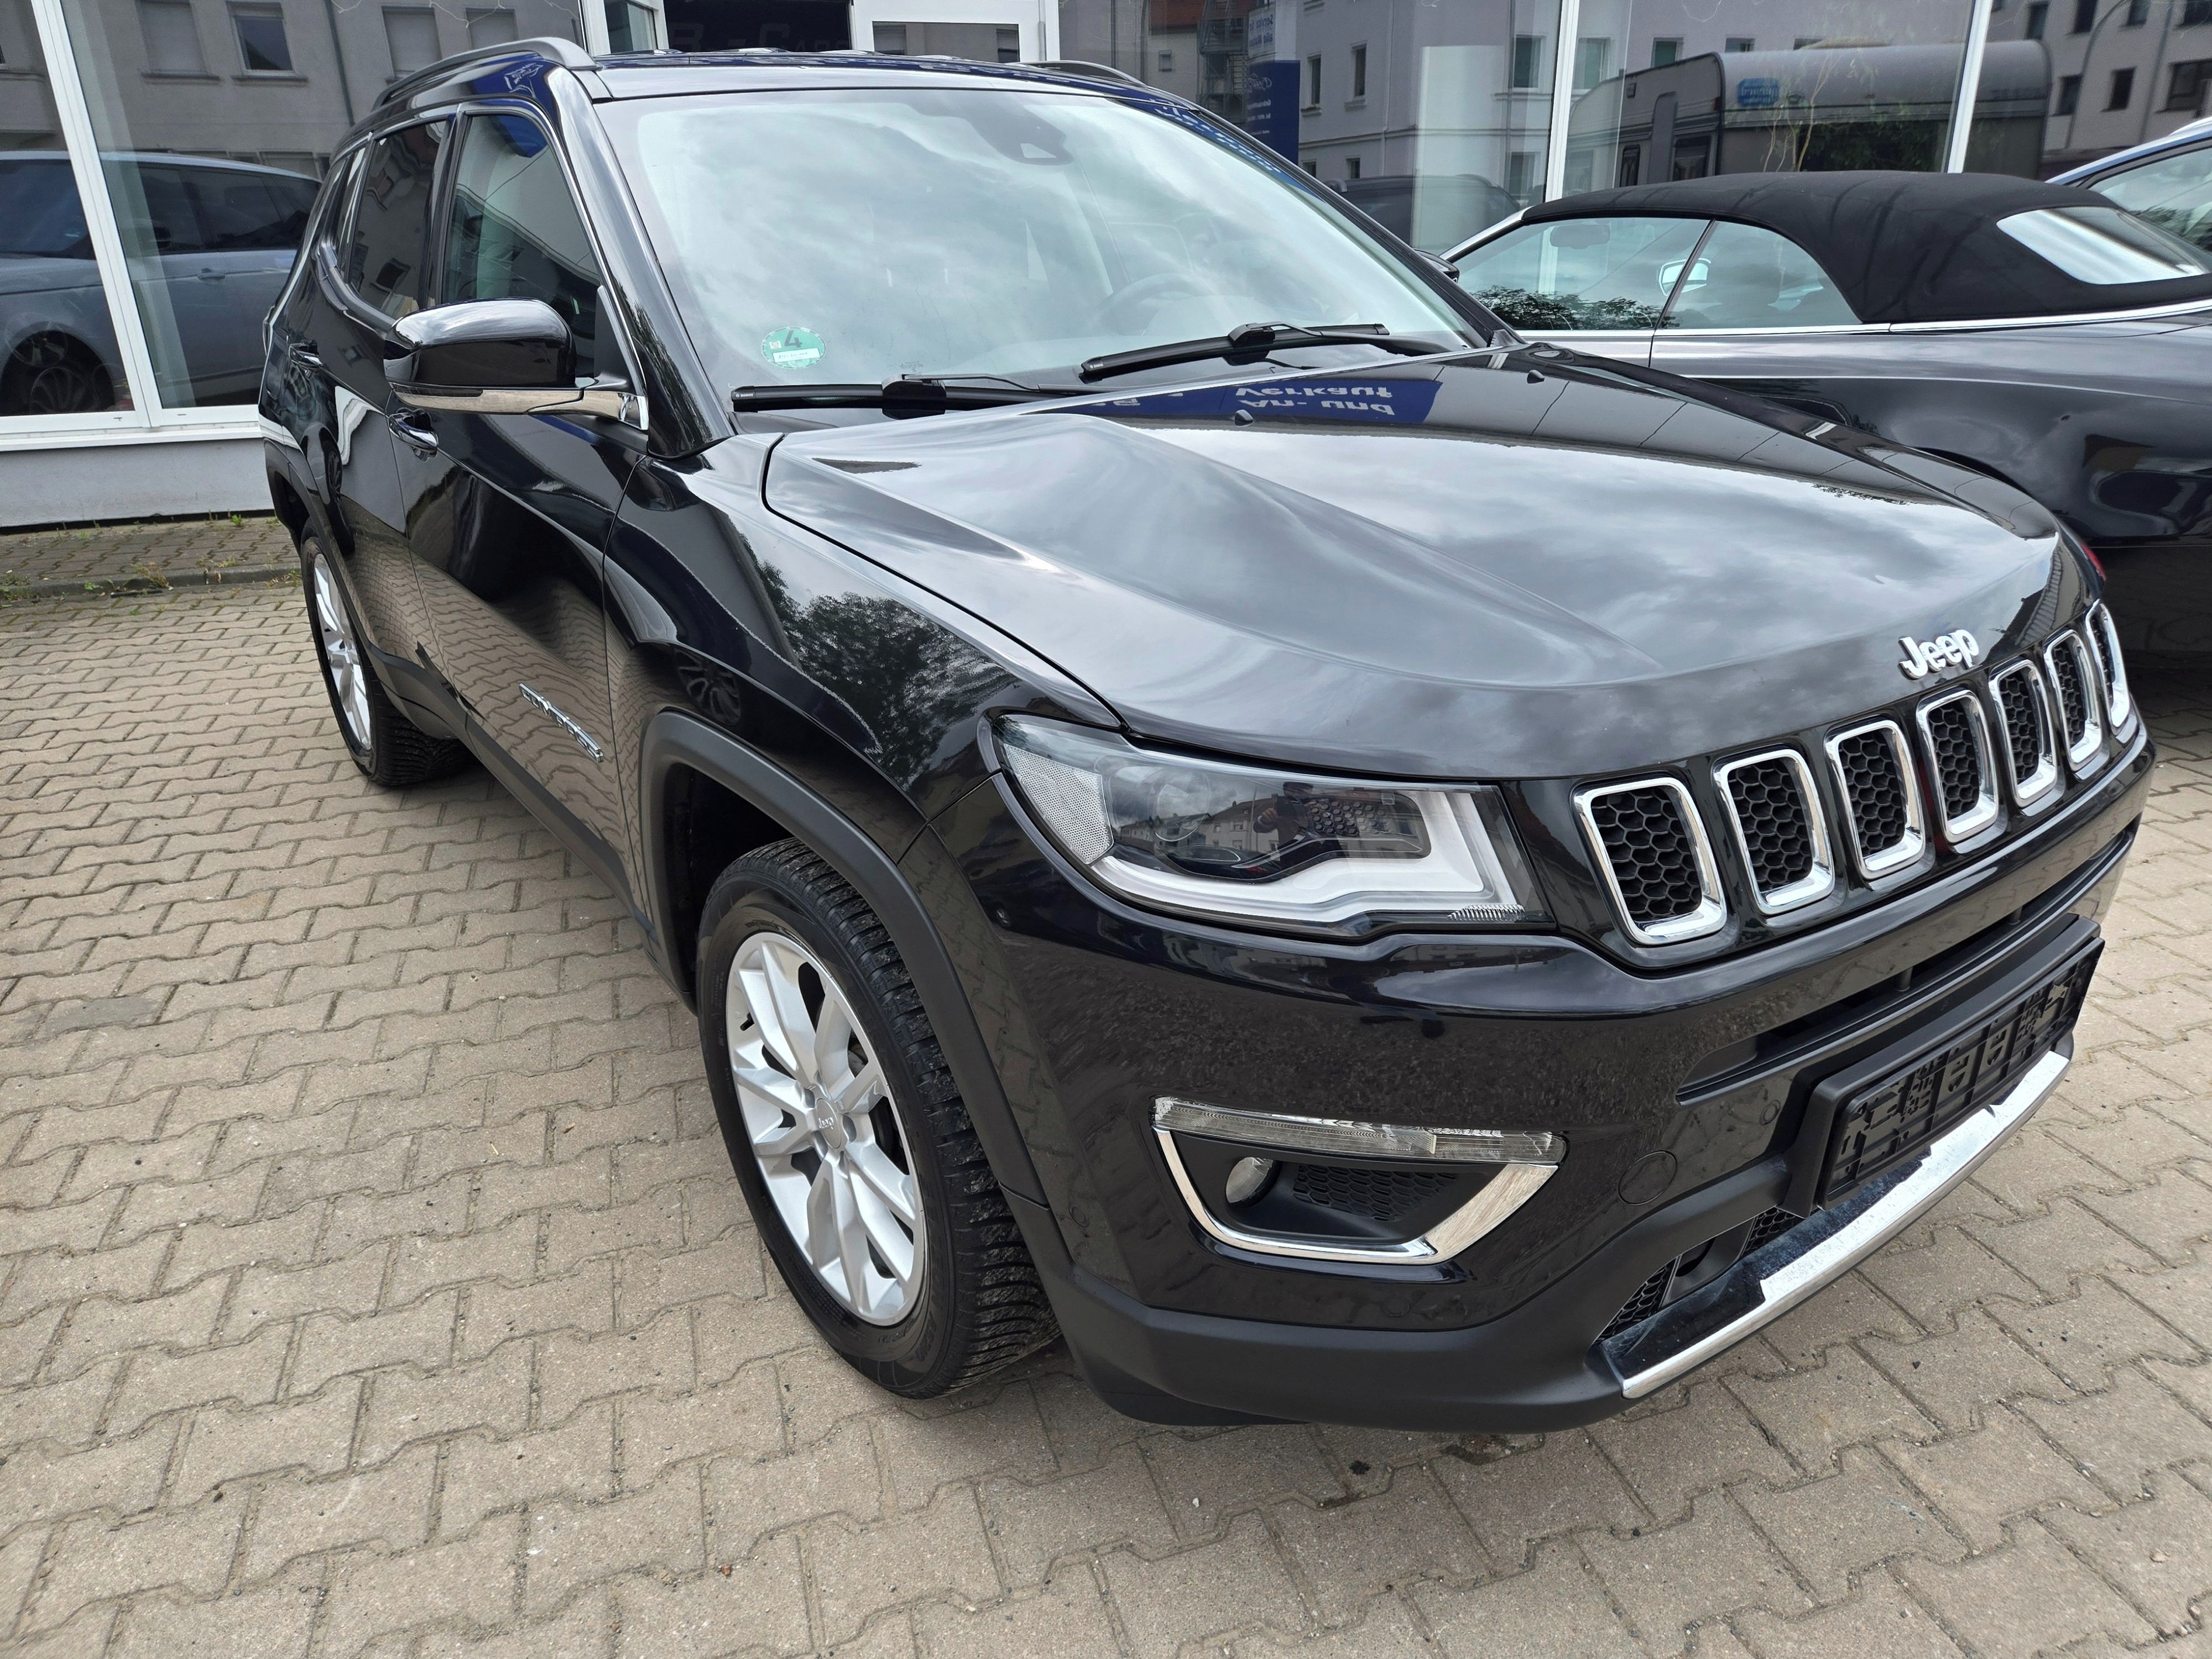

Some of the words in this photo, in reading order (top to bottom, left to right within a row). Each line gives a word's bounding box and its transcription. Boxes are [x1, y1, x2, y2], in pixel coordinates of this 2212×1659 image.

[785, 330, 802, 348] 4
[1898, 629, 1979, 680] Jeep
[818, 1117, 834, 1130] Jeep
